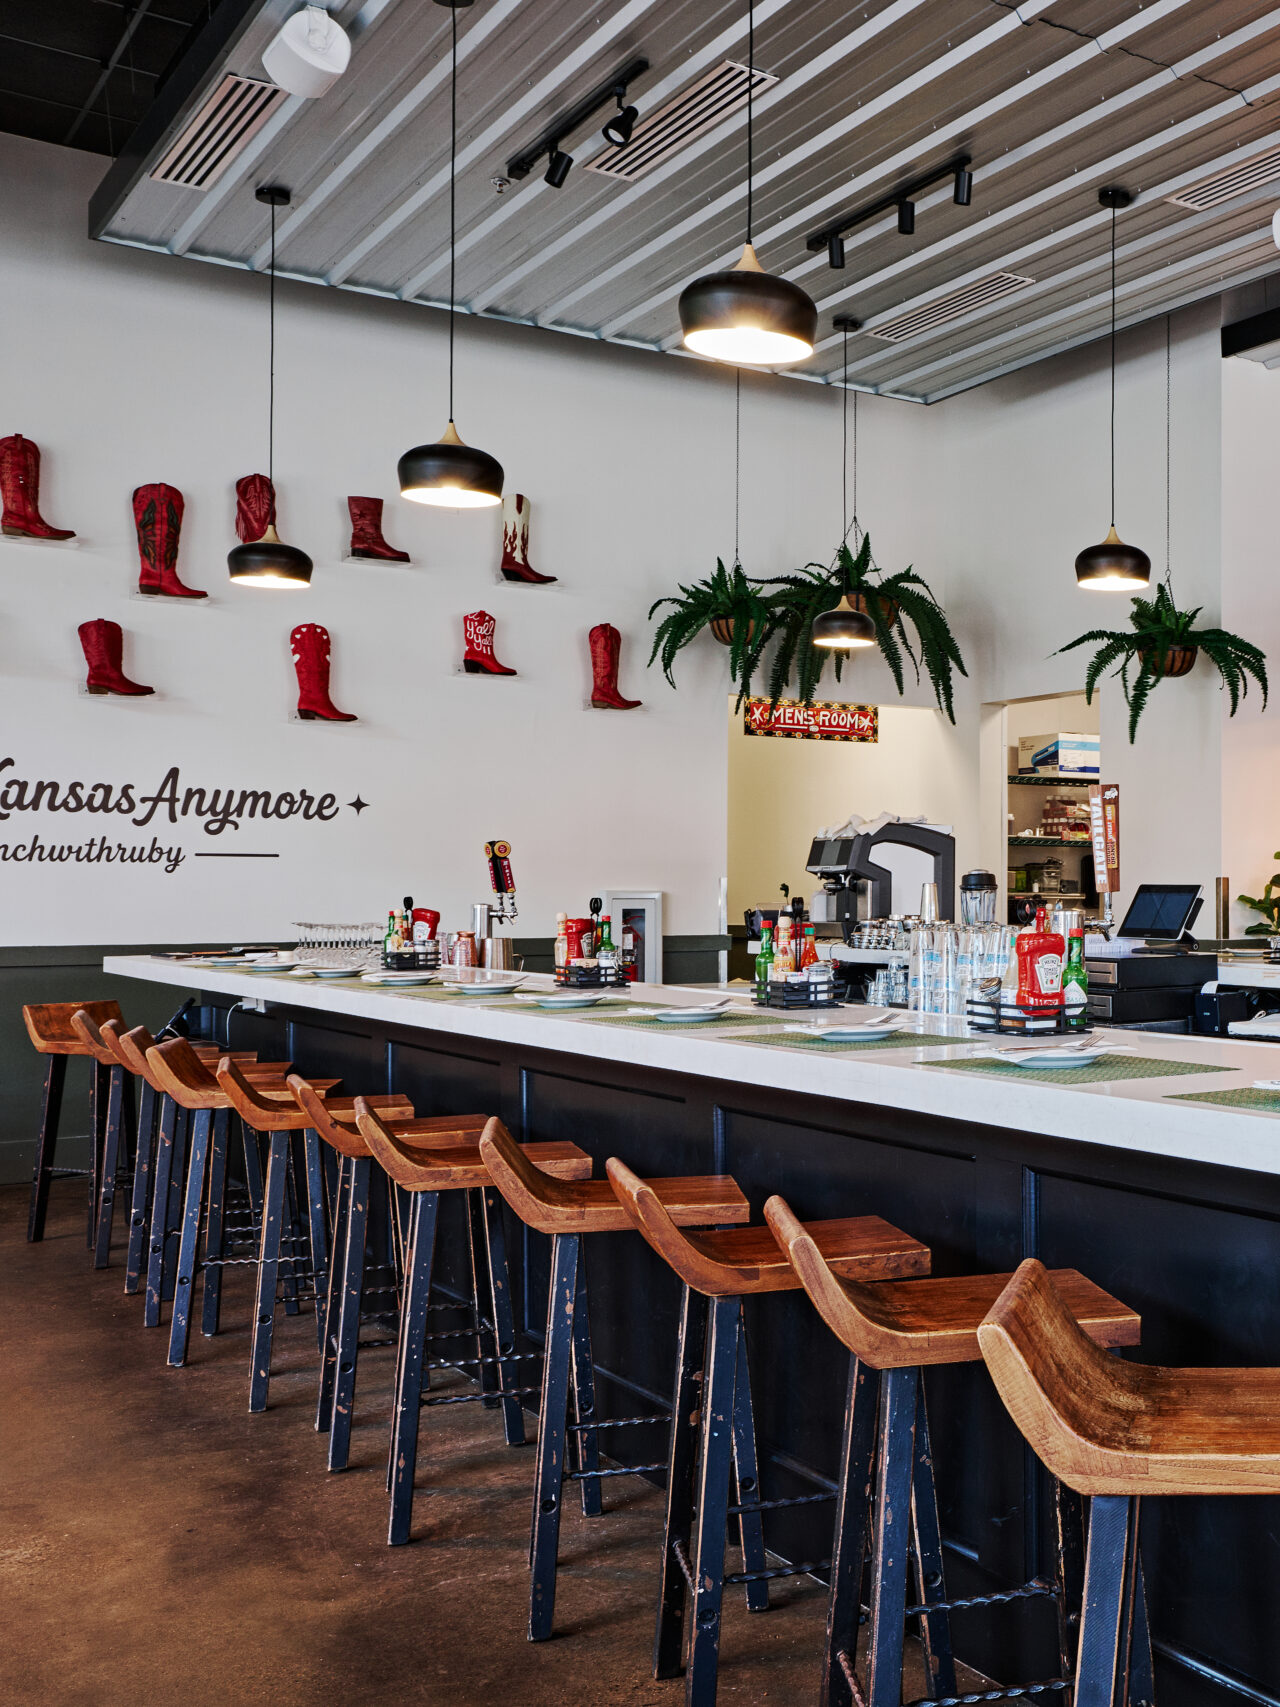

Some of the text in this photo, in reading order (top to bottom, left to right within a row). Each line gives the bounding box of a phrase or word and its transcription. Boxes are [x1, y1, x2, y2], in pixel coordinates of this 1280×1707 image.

[772, 707, 859, 729] MENS ROOM
[132, 767, 339, 835] Anymore
[1090, 795, 1108, 884] TAILGATE
